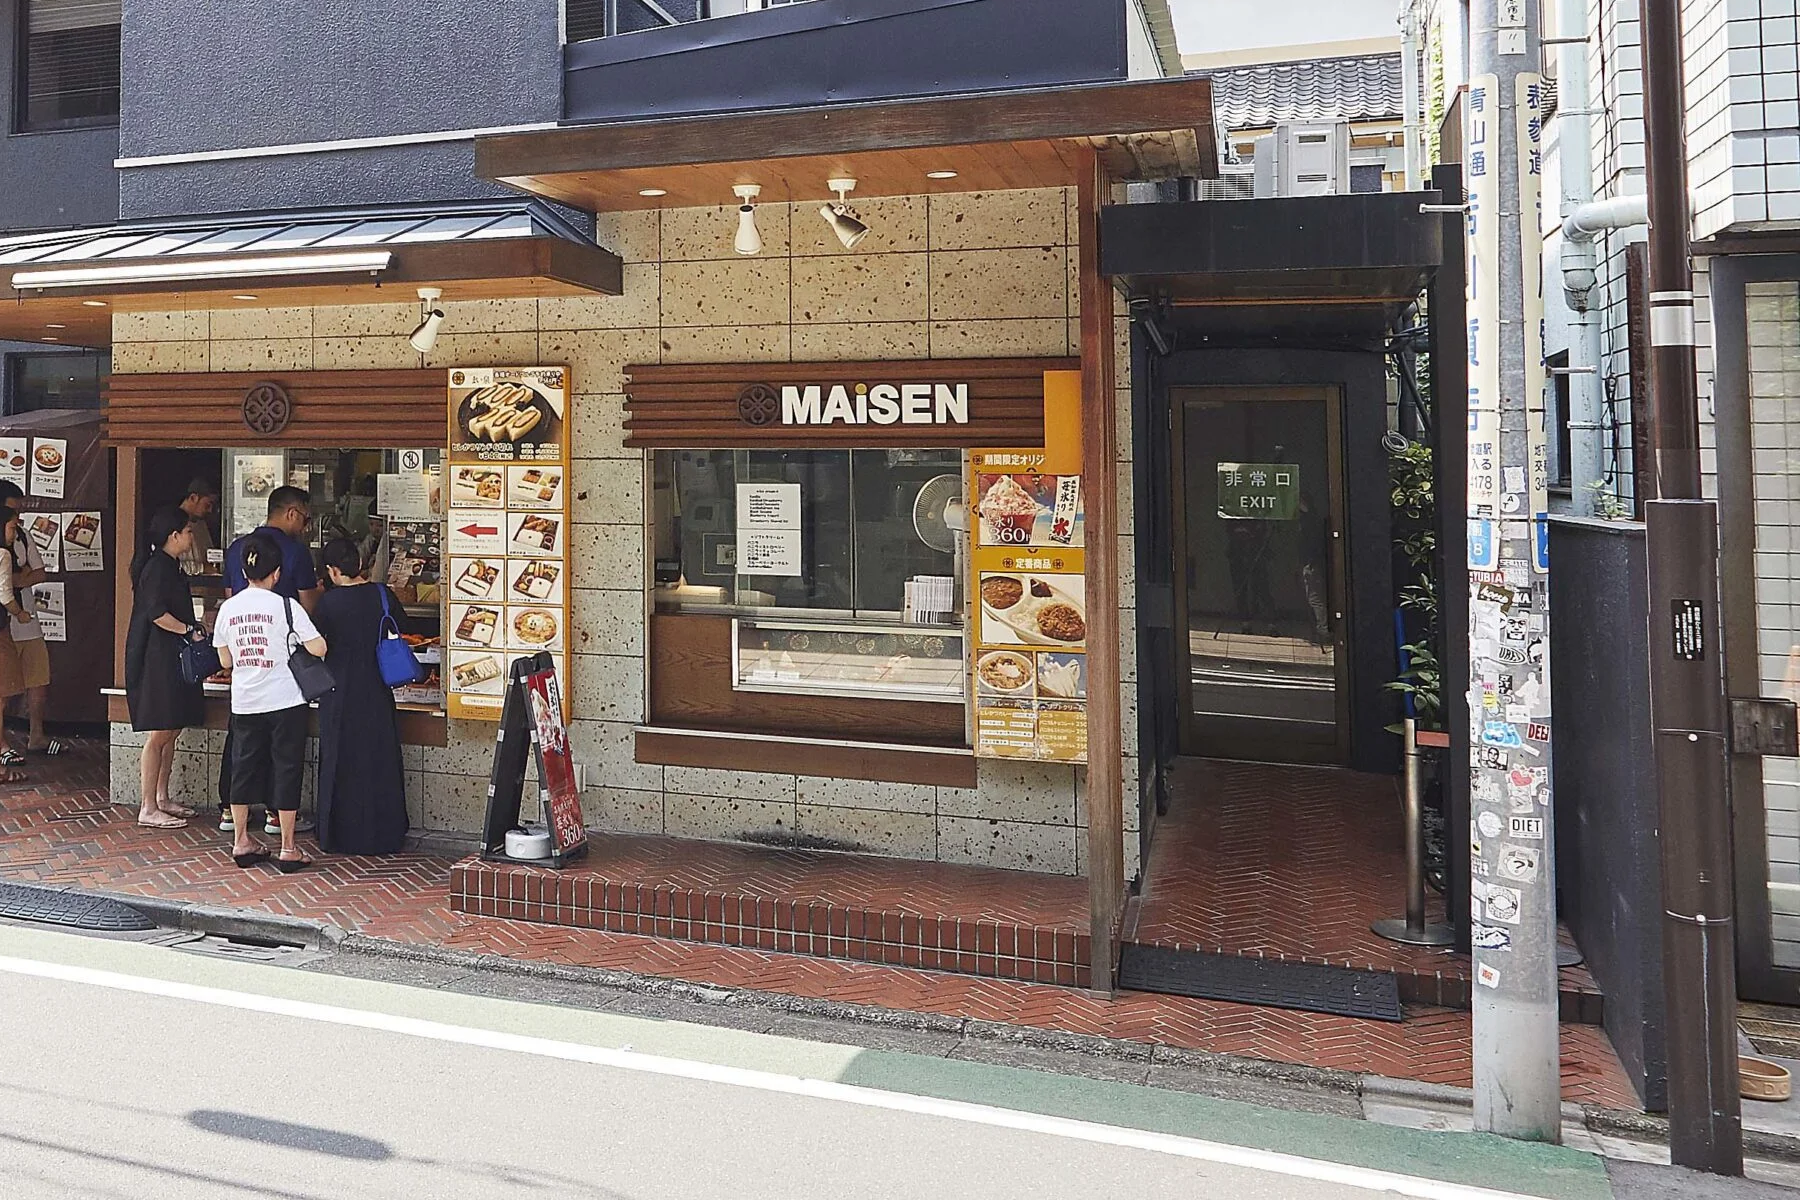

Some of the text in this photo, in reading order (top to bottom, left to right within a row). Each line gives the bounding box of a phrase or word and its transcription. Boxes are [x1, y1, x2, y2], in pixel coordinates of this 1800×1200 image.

[1225, 471, 1290, 487] 非常口
[1240, 496, 1276, 509] EXIT
[1512, 819, 1541, 832] DIET
